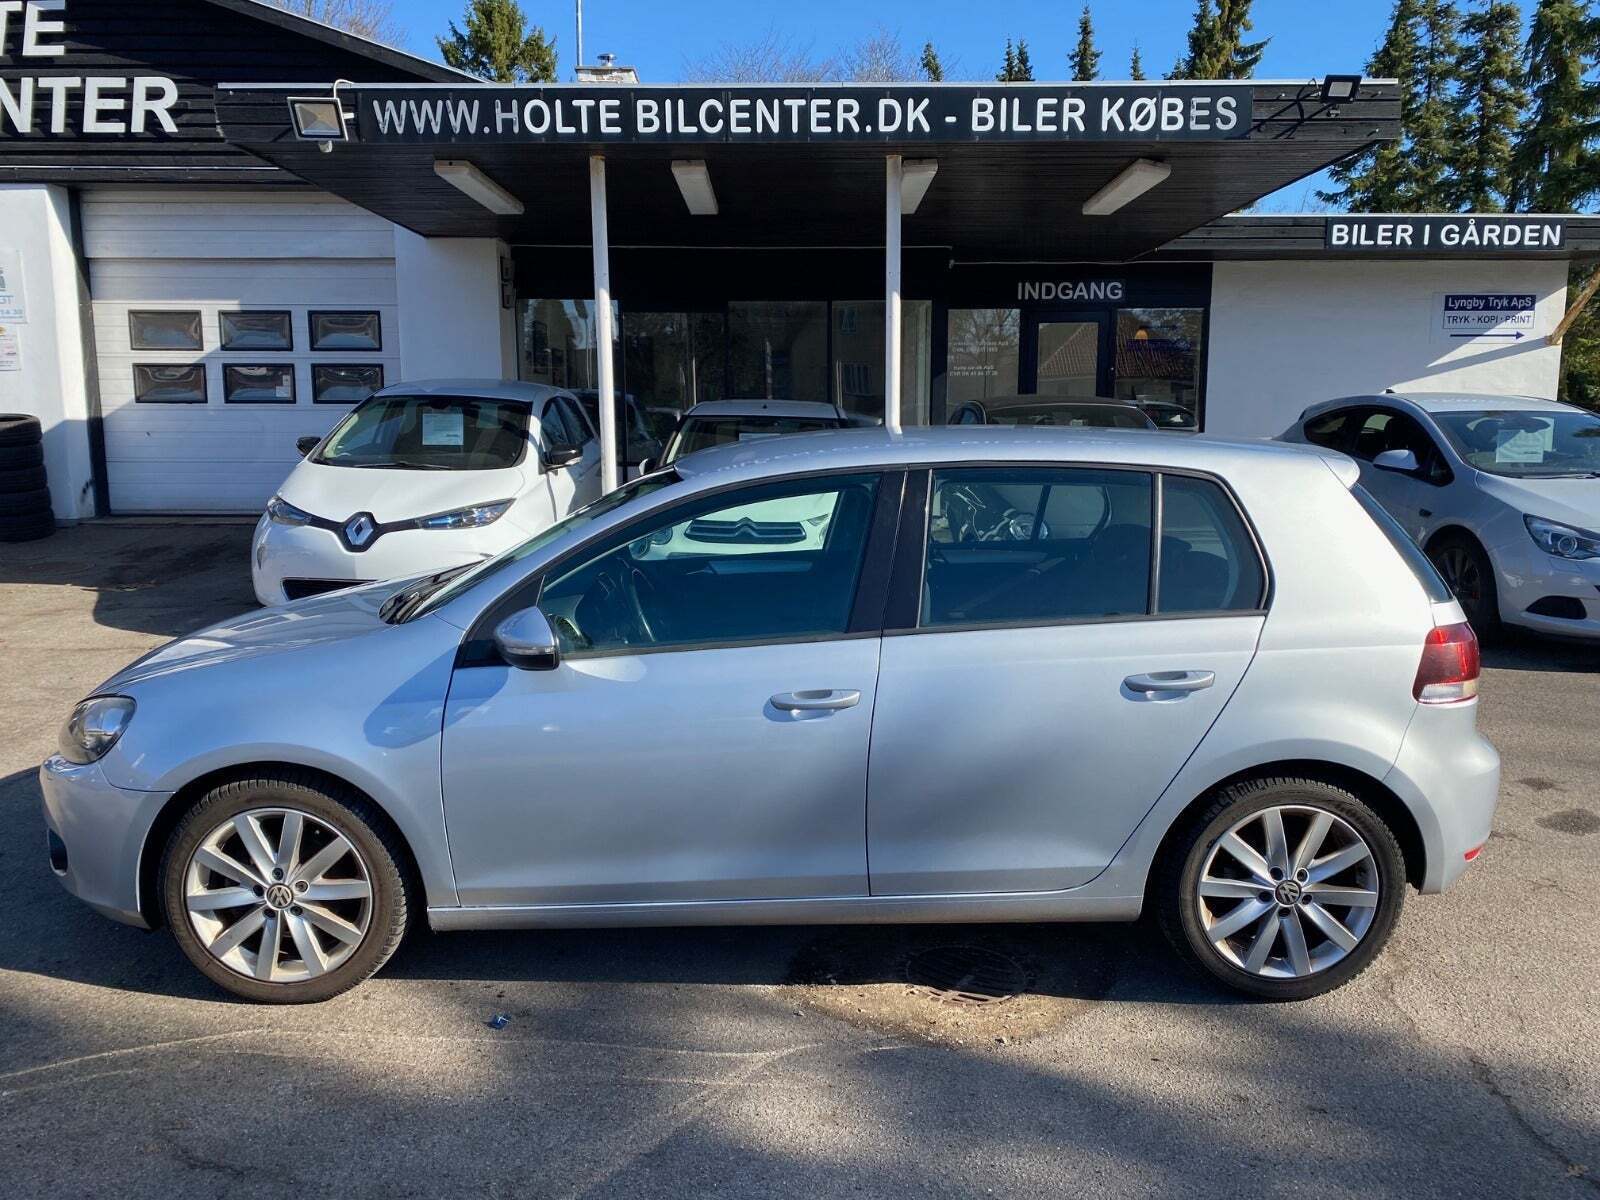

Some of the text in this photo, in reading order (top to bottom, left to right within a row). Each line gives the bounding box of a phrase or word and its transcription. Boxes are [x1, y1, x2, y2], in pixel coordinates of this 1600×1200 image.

[373, 99, 621, 134] WWW.HOLTE
[636, 98, 930, 134] BILCENTER.DK
[971, 98, 1086, 132] BILER
[1101, 96, 1238, 132] KØBES
[1331, 218, 1561, 246] BILER I GÅRDEN
[1017, 281, 1123, 300] INDGANG
[1448, 297, 1532, 309] Lyngby Tryk ApS
[1447, 315, 1532, 324] TRYK KOPI PRINT
